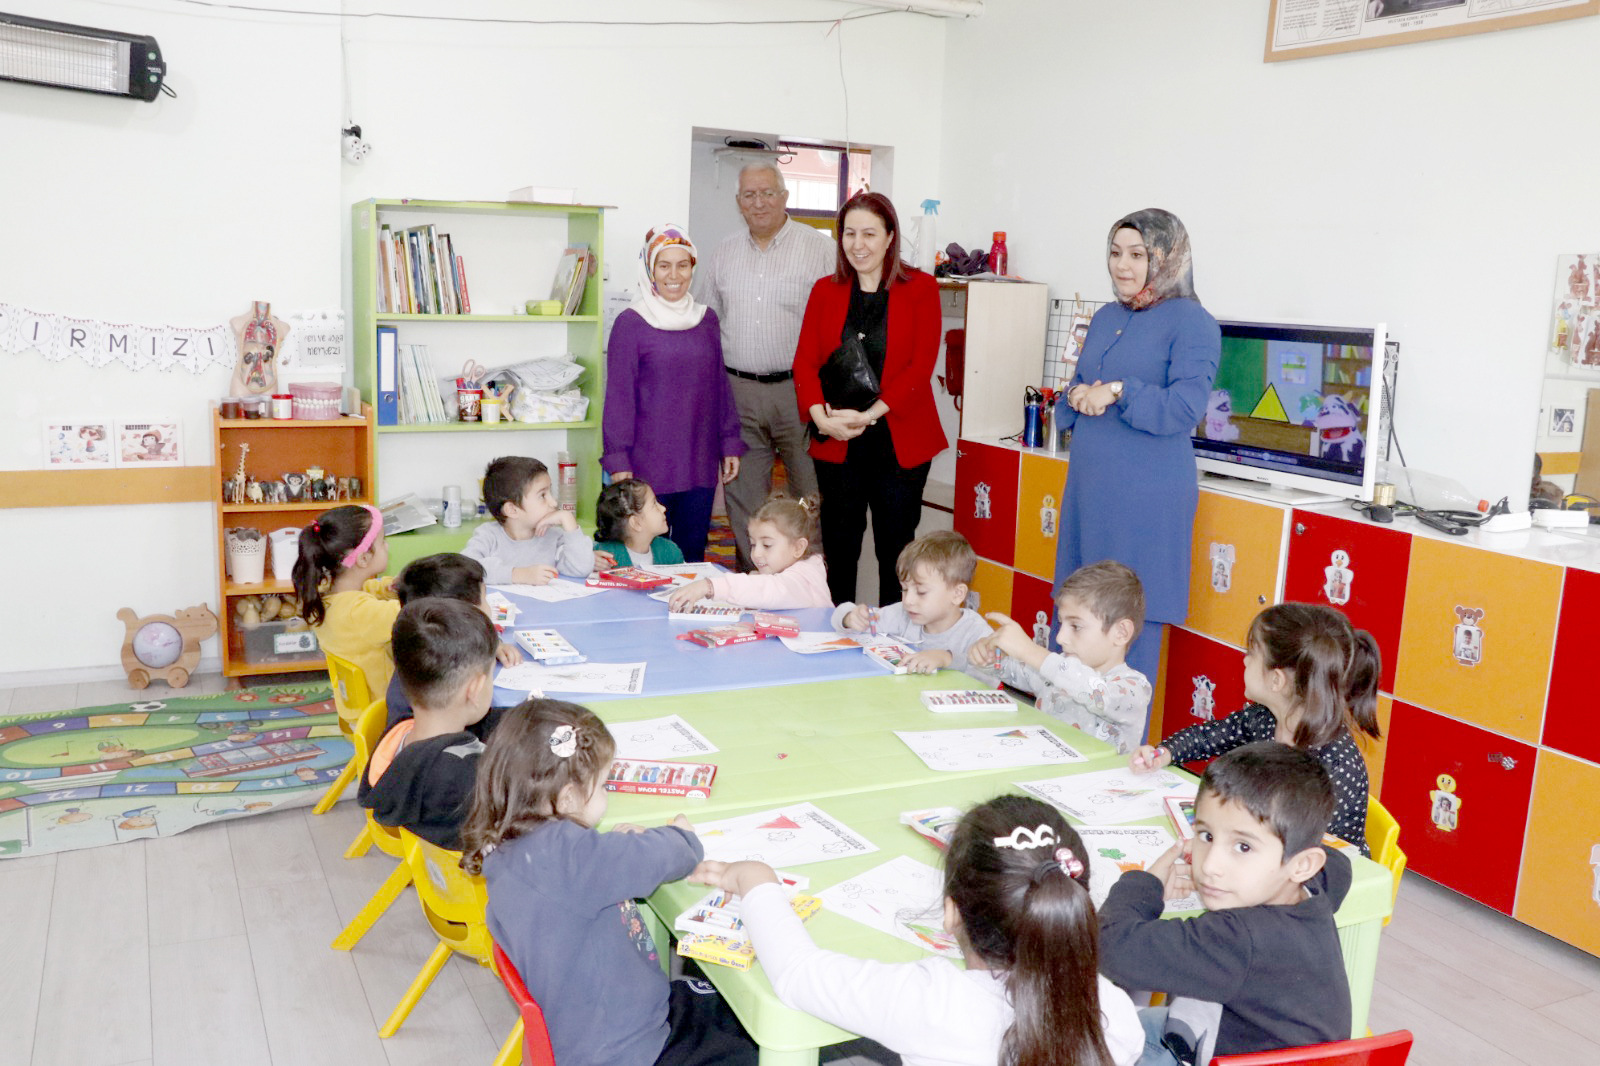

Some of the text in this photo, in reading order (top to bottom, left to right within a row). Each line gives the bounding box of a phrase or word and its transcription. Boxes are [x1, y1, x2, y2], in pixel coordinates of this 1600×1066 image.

[0, 313, 214, 356] IRMIZI
[6, 771, 32, 779] 10
[191, 783, 221, 791] 20
[261, 778, 284, 787] 19
[125, 784, 149, 793] 21
[47, 790, 77, 800] 22
[681, 944, 690, 952] 12
